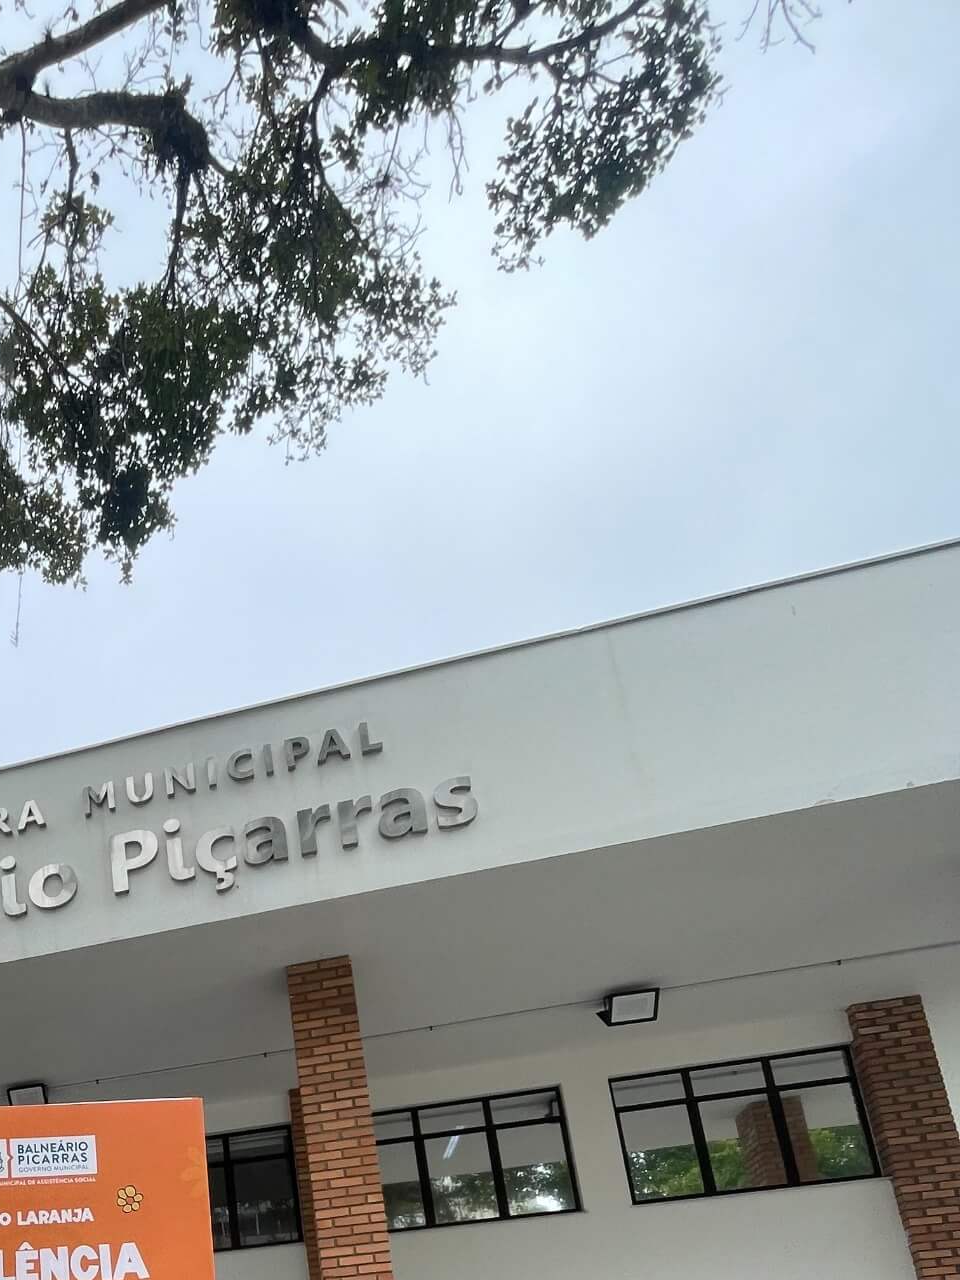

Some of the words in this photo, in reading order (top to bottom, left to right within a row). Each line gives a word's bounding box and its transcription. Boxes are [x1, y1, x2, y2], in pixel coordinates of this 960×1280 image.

[84, 722, 383, 818] MUNICIPAL
[111, 775, 479, 896] Piçarras
[17, 1140, 89, 1154] BALNEÁRIO
[18, 1165, 52, 1173] GOVERNO
[17, 1207, 94, 1226] LARANJA
